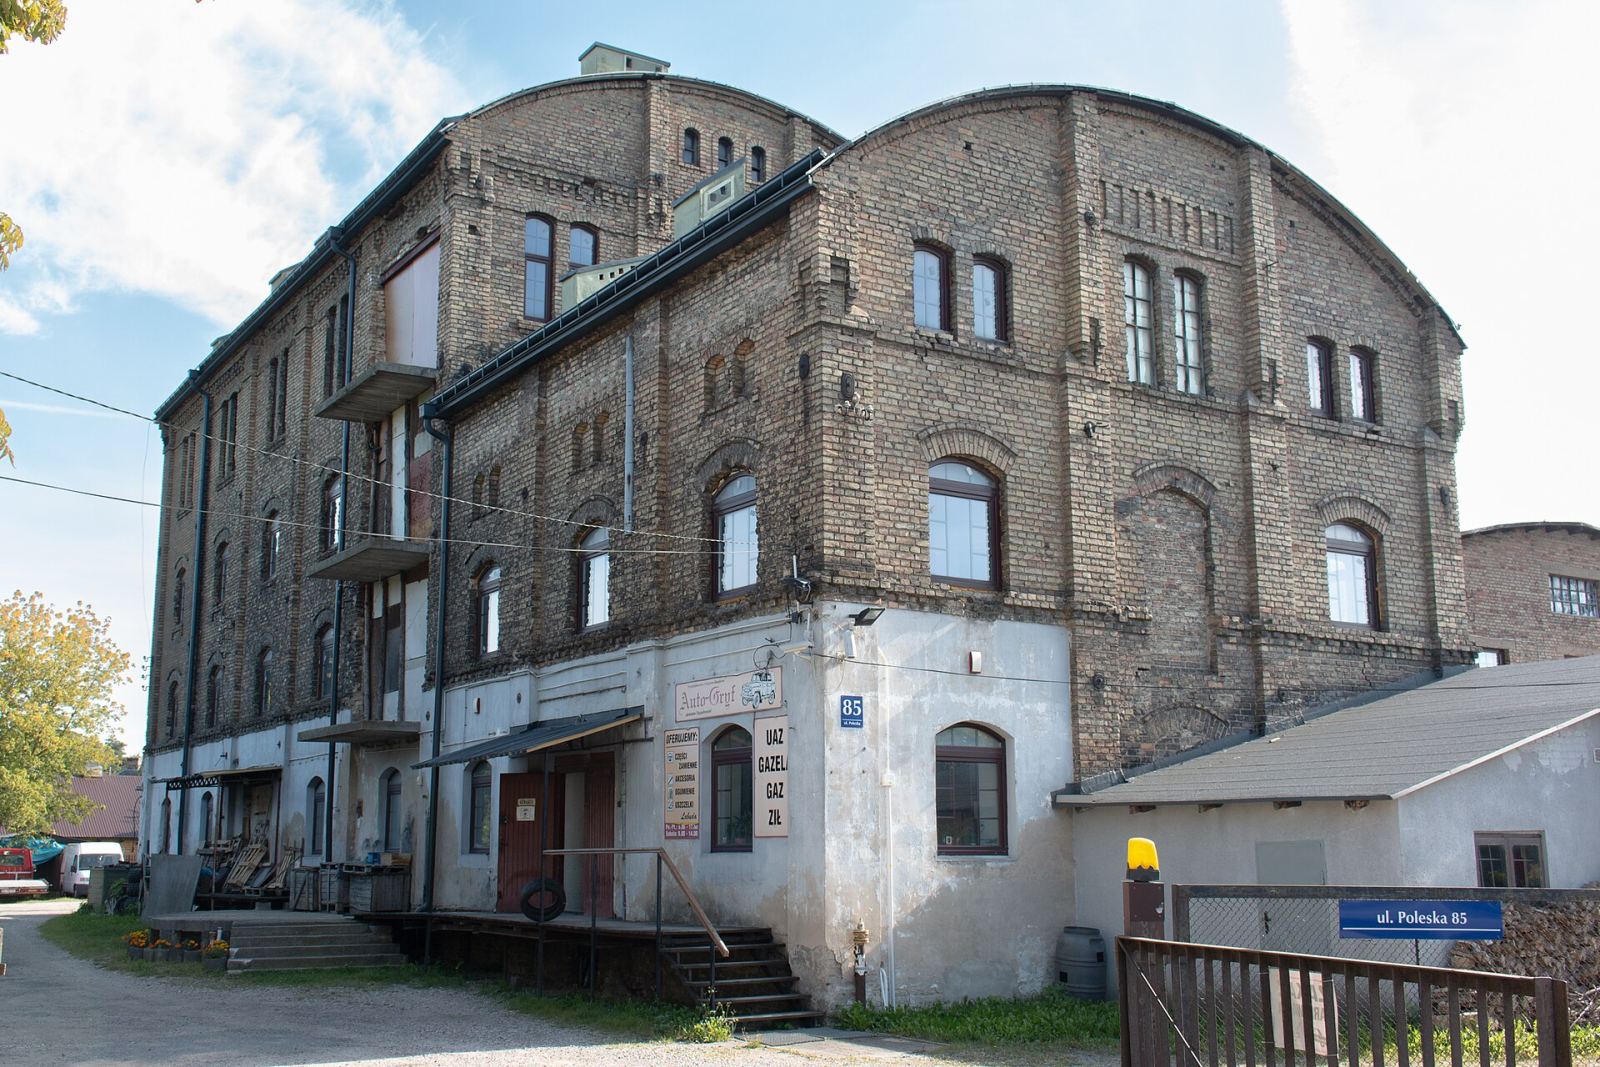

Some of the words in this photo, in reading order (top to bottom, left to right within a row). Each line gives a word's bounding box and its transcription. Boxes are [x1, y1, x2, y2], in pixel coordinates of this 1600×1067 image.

[680, 684, 736, 711] Auto-Gryf
[842, 699, 862, 716] 85
[665, 731, 698, 745] OFERUJEMY:
[766, 728, 784, 746] UAZ
[766, 782, 784, 799] GAZ
[768, 808, 782, 826] ZIŁ
[1376, 910, 1393, 924] ul.
[1398, 911, 1448, 925] Poleska
[1451, 912, 1468, 925] 85
